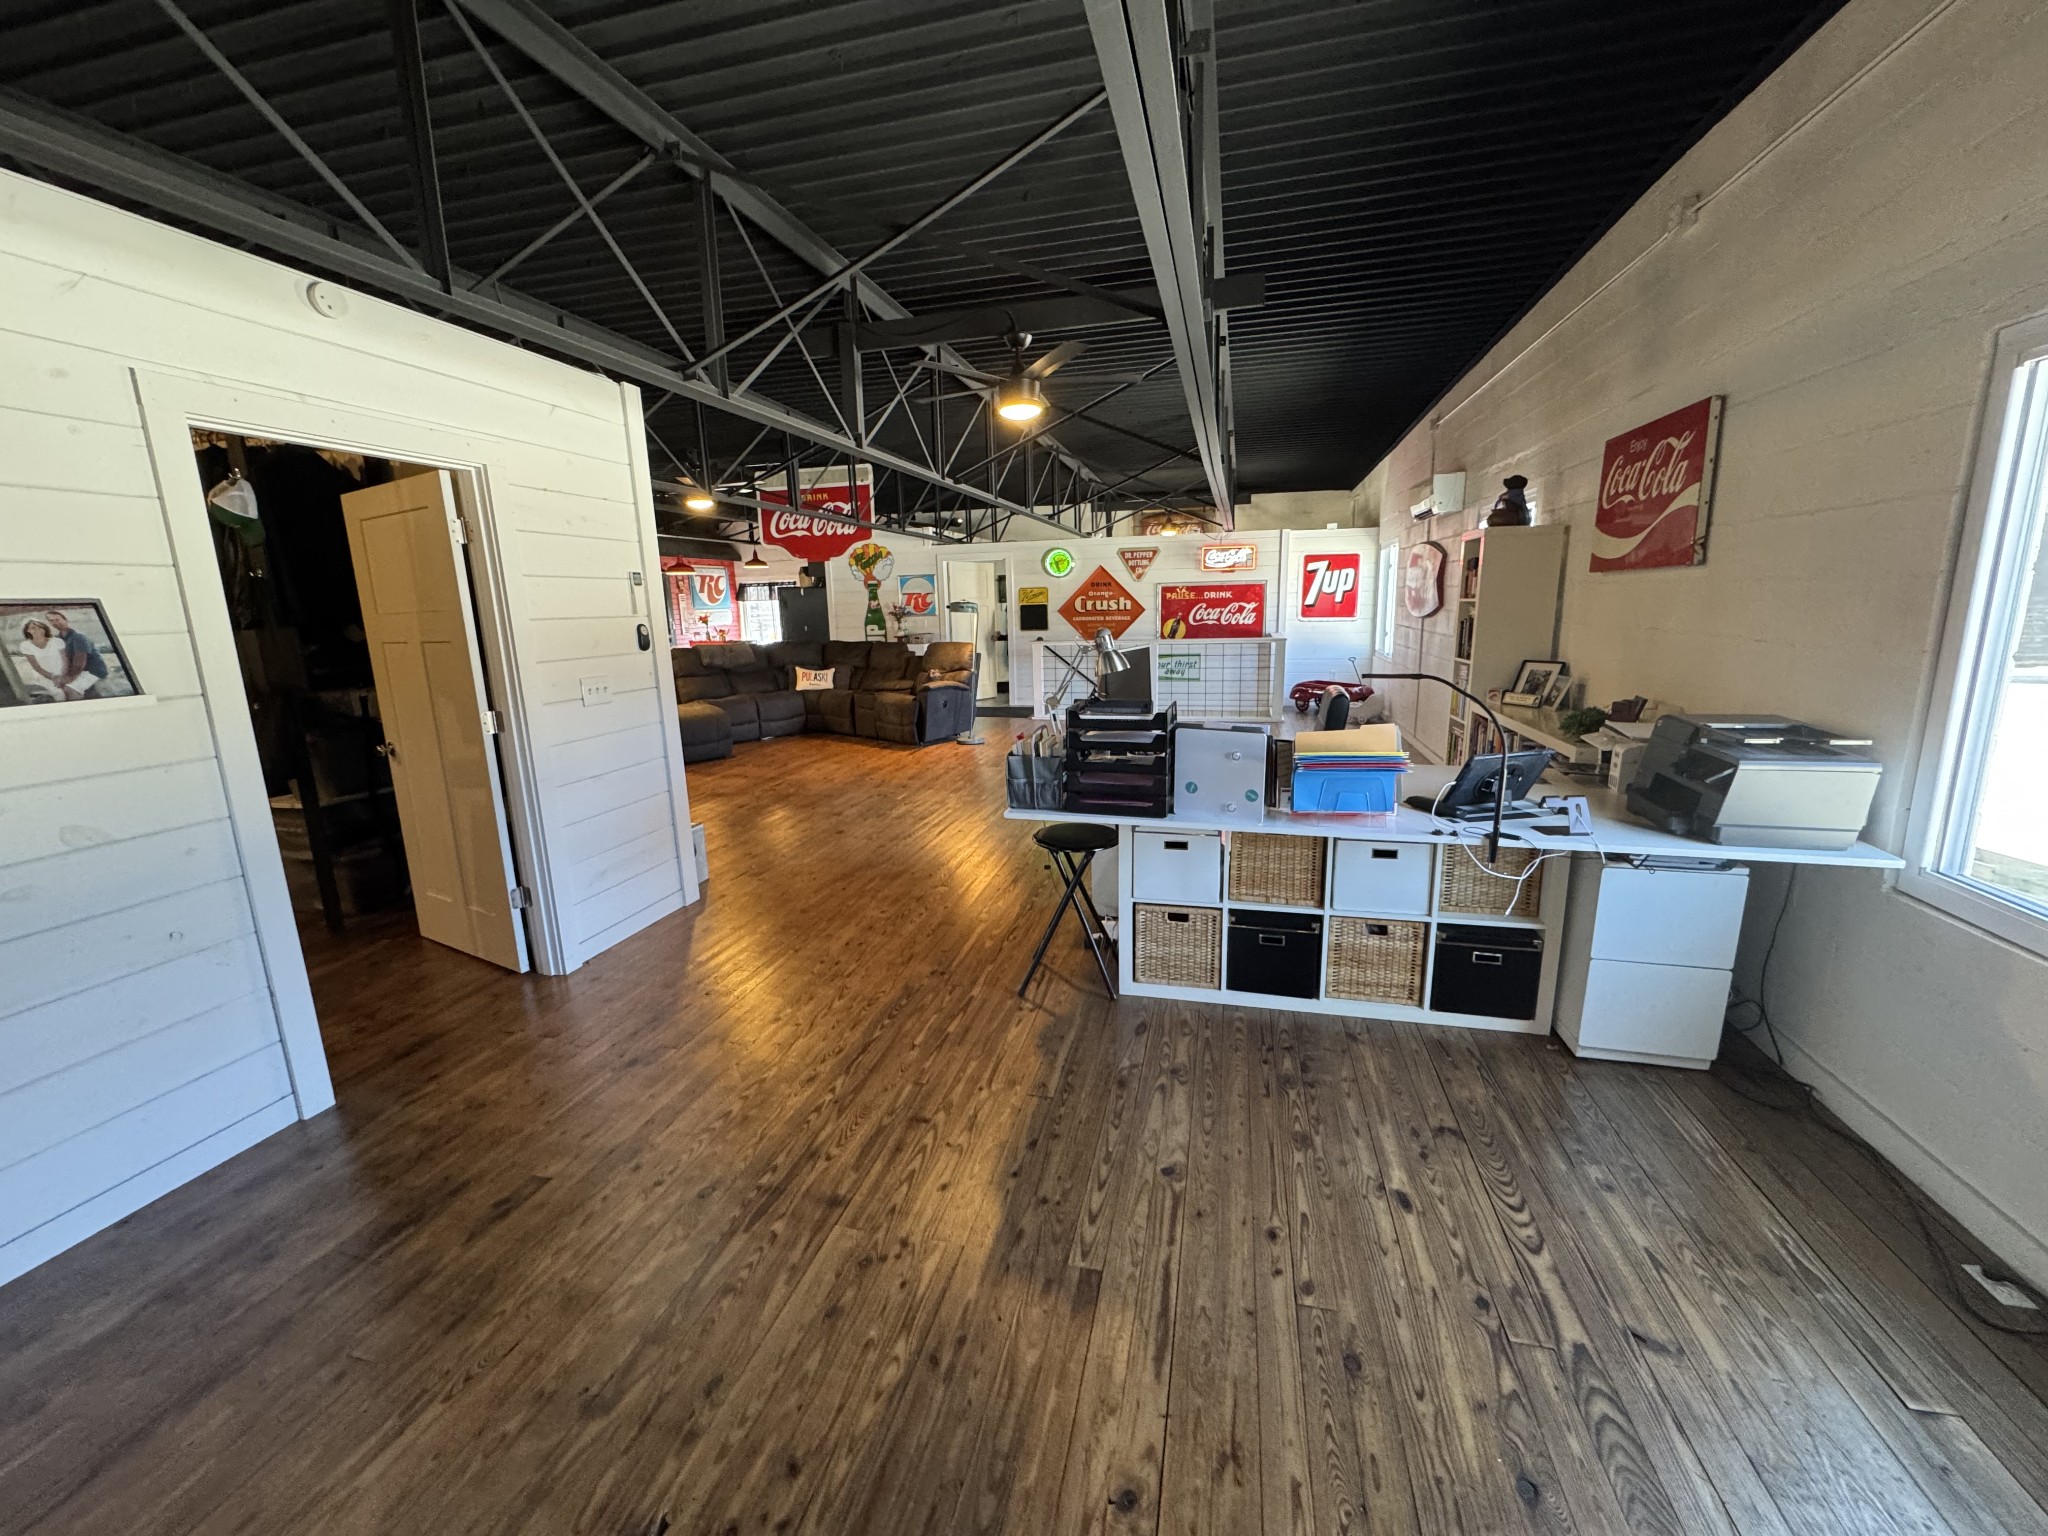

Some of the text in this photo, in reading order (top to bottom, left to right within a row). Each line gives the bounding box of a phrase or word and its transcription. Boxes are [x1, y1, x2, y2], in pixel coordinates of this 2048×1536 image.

[1602, 428, 1697, 509] Coca-Cola
[1128, 559, 1150, 567] BOTTLING
[695, 574, 725, 604] RC
[902, 592, 934, 614] RC
[1074, 595, 1132, 613] Crush
[1188, 601, 1260, 625] Coca-Cola
[1164, 669, 1186, 677] away
[1174, 660, 1197, 669] thirst
[801, 672, 829, 682] PULASKI
